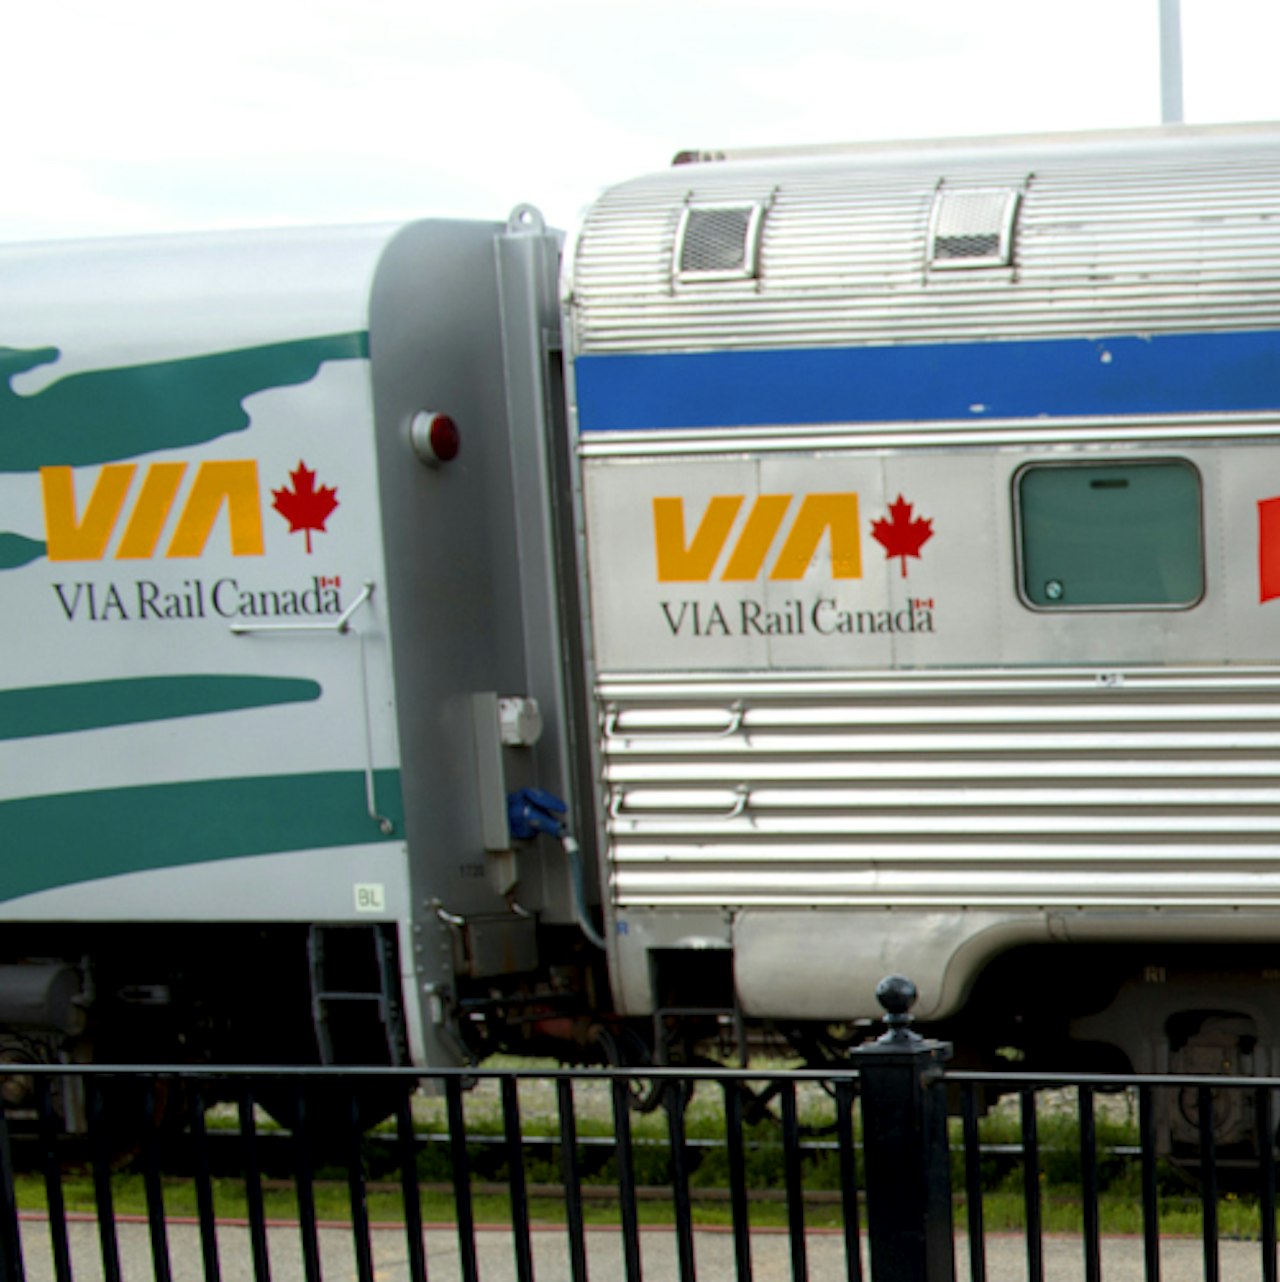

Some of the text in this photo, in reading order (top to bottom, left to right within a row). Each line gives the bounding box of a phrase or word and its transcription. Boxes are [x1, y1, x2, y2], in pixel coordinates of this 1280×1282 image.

[40, 459, 265, 562] VIA
[652, 492, 864, 583] VIA
[53, 576, 342, 620] VIA Rail Canada
[660, 599, 935, 636] VIA Rail Canada
[358, 888, 382, 907] BL
